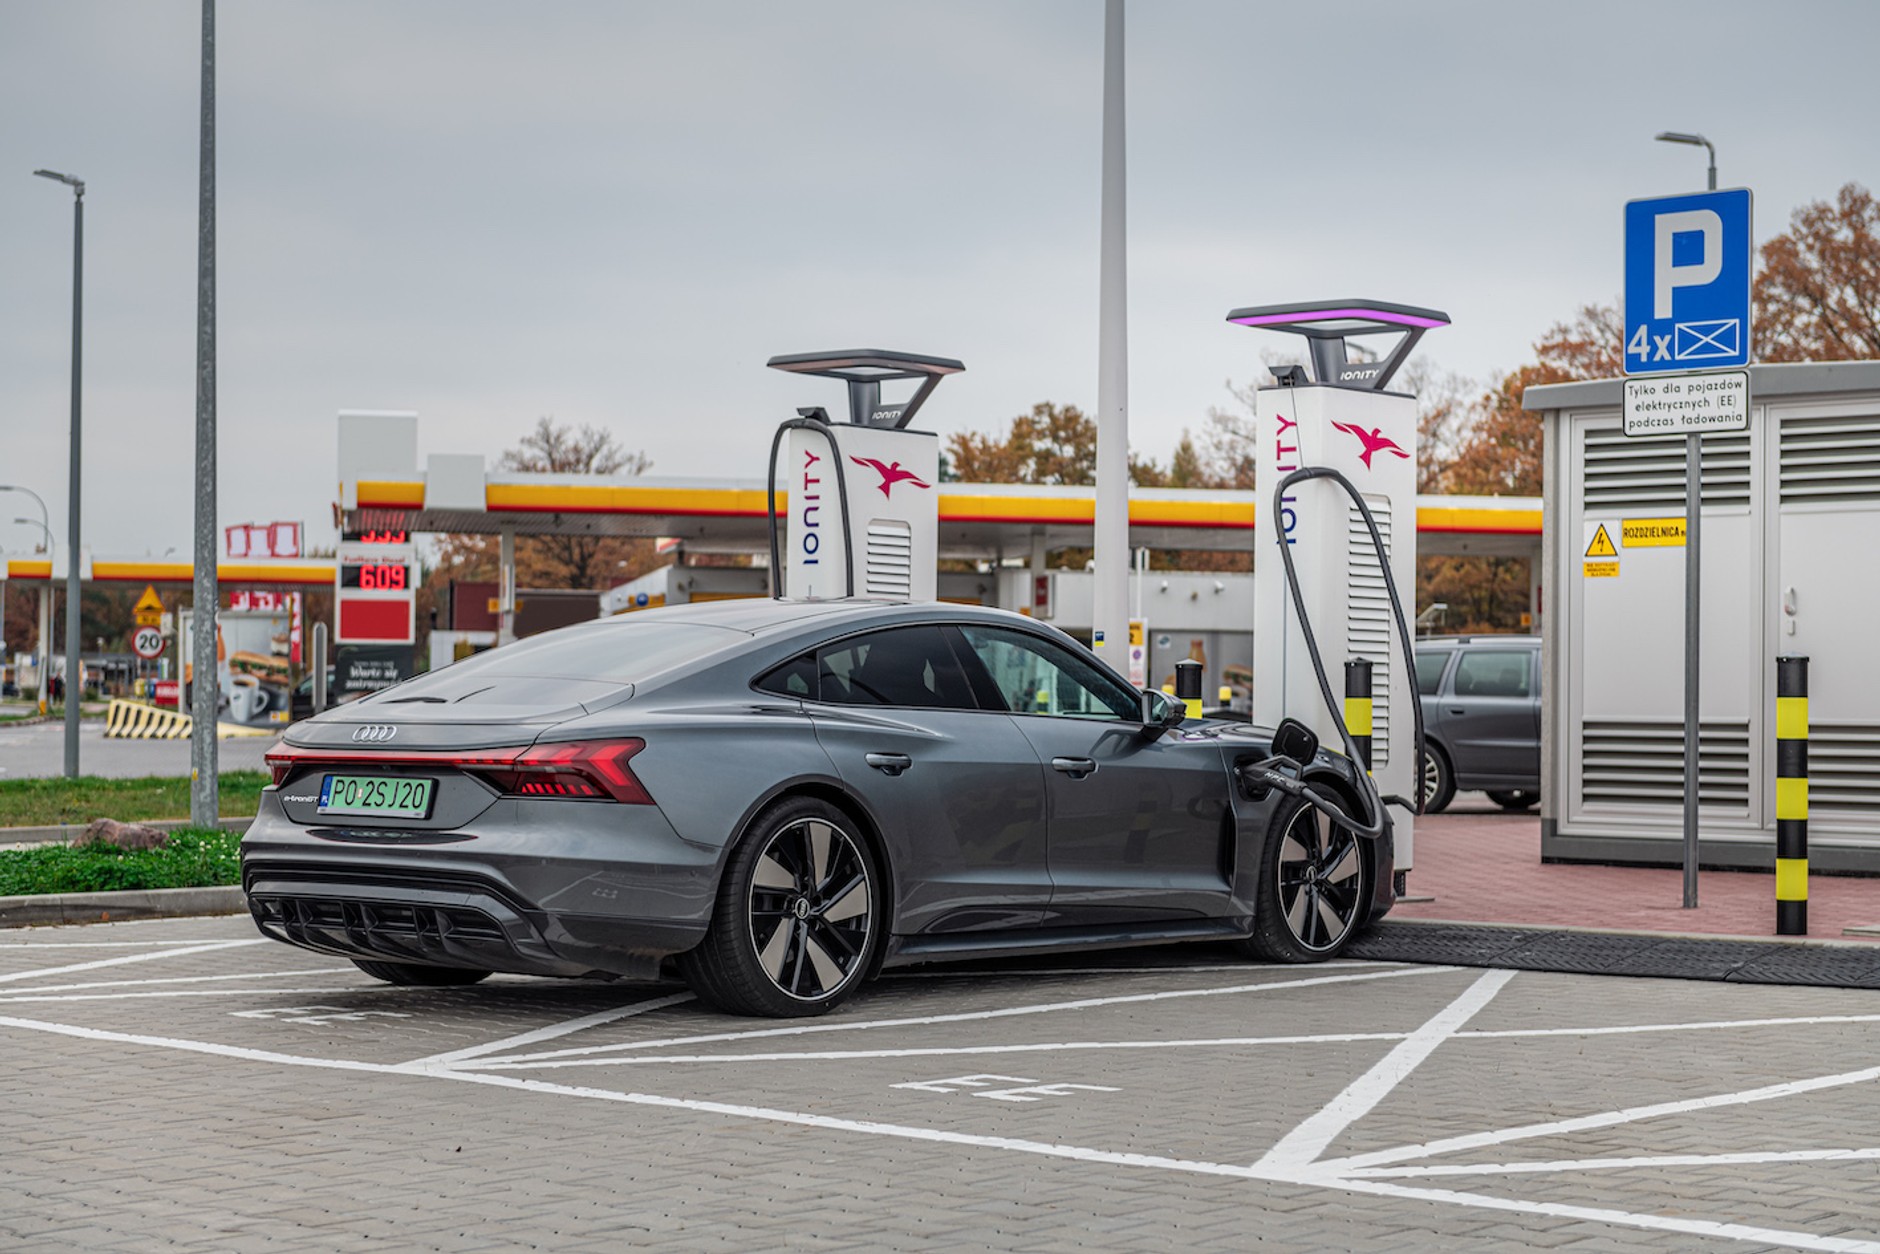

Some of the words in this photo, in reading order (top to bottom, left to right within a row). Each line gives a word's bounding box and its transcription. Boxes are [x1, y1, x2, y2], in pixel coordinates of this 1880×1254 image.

[1654, 209, 1723, 320] P
[1627, 324, 1673, 362] 4x
[1340, 369, 1380, 381] IONITY
[1628, 385, 1656, 399] Tylko
[1662, 383, 1681, 394] dla
[1688, 379, 1743, 396] pojazdów
[1635, 398, 1710, 413] elektrycznych
[1716, 394, 1737, 409] (EE)
[1629, 416, 1674, 431] podczas
[1681, 411, 1743, 425] ładowania
[803, 450, 821, 565] IONITY
[1623, 526, 1680, 538] ROZDZIELNICA
[360, 564, 405, 591] 609
[139, 634, 160, 650] 20
[361, 780, 425, 809] 2SJ20
